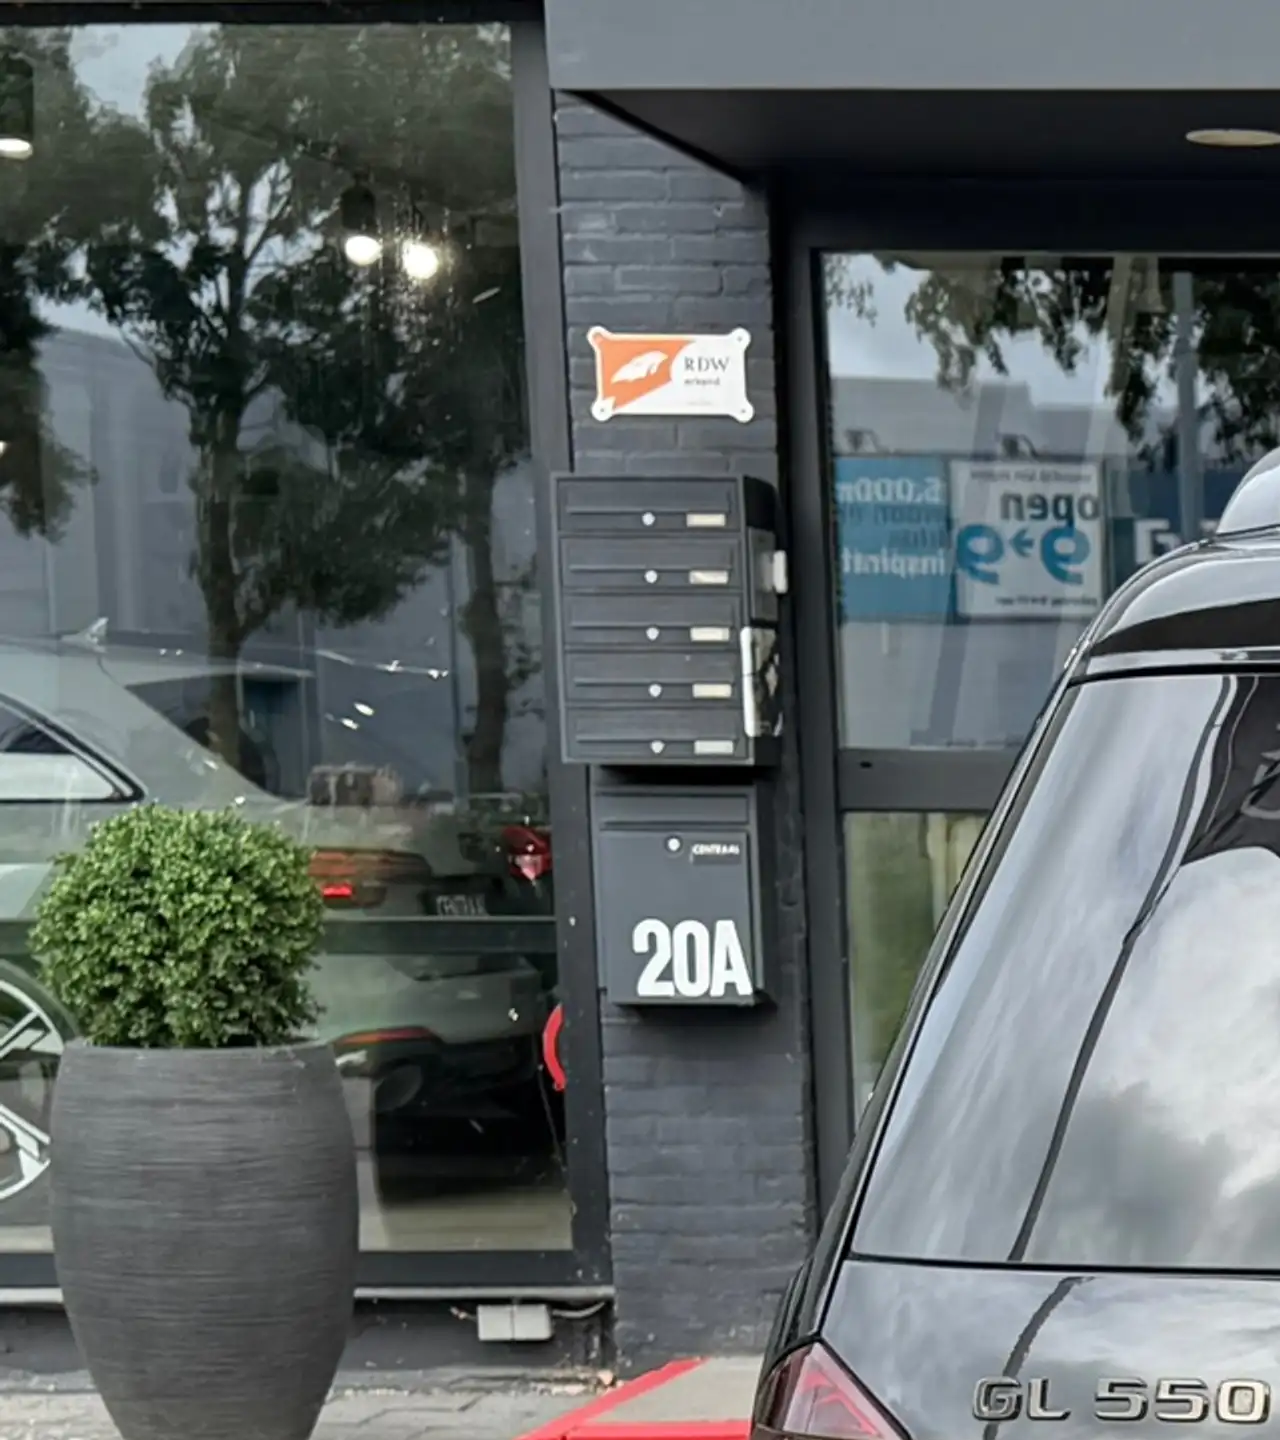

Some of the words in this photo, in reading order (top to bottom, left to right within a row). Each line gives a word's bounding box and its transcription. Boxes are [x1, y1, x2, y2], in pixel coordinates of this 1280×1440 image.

[684, 356, 730, 372] RDW
[632, 918, 754, 997] 20A
[972, 1376, 1071, 1421] GL
[1094, 1376, 1272, 1423] 550
